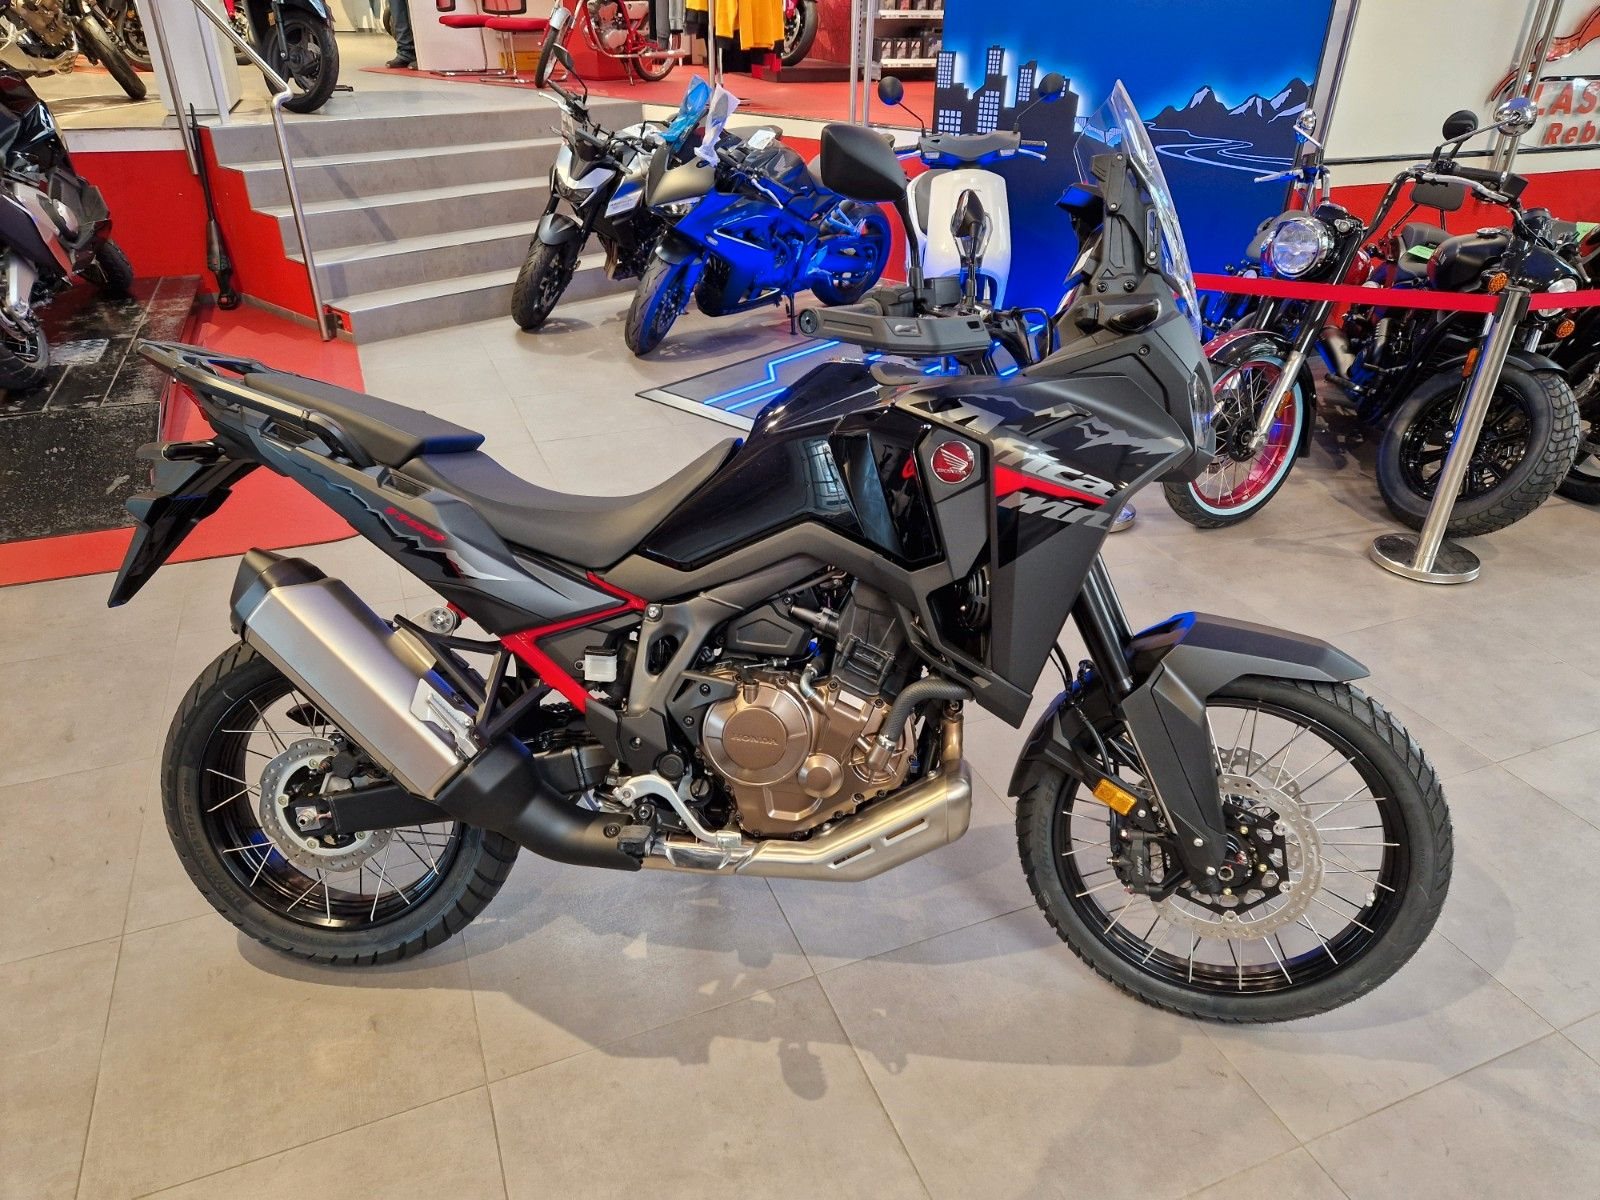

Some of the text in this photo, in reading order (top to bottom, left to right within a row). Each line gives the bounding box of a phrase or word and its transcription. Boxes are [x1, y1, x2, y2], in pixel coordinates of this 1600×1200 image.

[1506, 81, 1600, 116] LAS
[1544, 120, 1600, 145] Reb
[730, 734, 779, 746] HONDA
